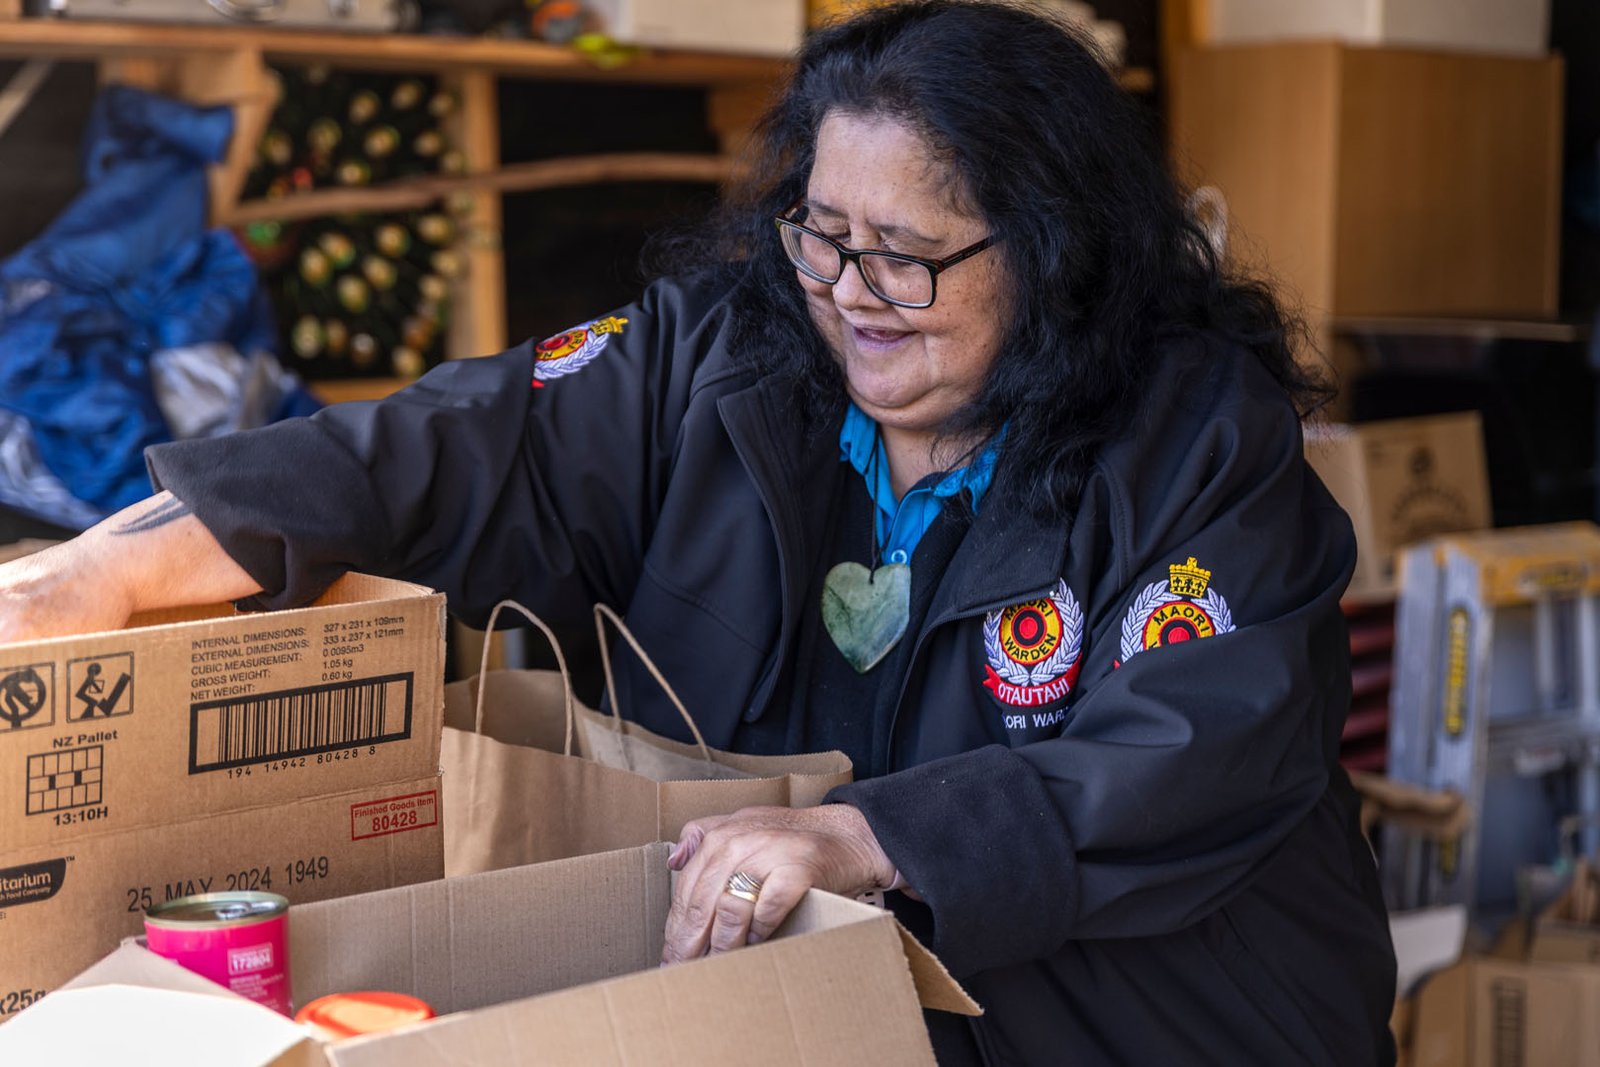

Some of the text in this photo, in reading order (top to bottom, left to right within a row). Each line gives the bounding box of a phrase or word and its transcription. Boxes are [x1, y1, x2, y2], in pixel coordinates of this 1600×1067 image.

[1153, 606, 1210, 632] MAORI
[191, 636, 240, 650] INTERNAL
[243, 627, 307, 643] DIMENSIONS:
[323, 623, 339, 633] 327
[348, 620, 364, 630] 231
[191, 648, 243, 663] EXTERNAL
[246, 639, 310, 655] DIMENSIONS:
[323, 635, 339, 645] 333
[348, 632, 364, 642] 237
[374, 628, 404, 639] 121mm
[1004, 633, 1057, 661] WARDEN
[191, 664, 223, 676] CUBIC
[224, 653, 303, 671] MEASUREMENT:
[191, 658, 353, 688] GROSS WEIGHT: 1.05 kg
[190, 670, 352, 701] NET WEIGHT: 0.60 kg
[998, 678, 1070, 705] OTAUTAHI
[1032, 707, 1067, 728] WAR
[53, 730, 118, 748] NZ Pallet
[227, 746, 376, 779] 194 14942 80428 8
[53, 806, 108, 826] 13:10H
[354, 797, 434, 818] Finished Goods Item
[372, 810, 417, 832] 80428
[127, 856, 329, 912] 25 MAY 2024 1949
